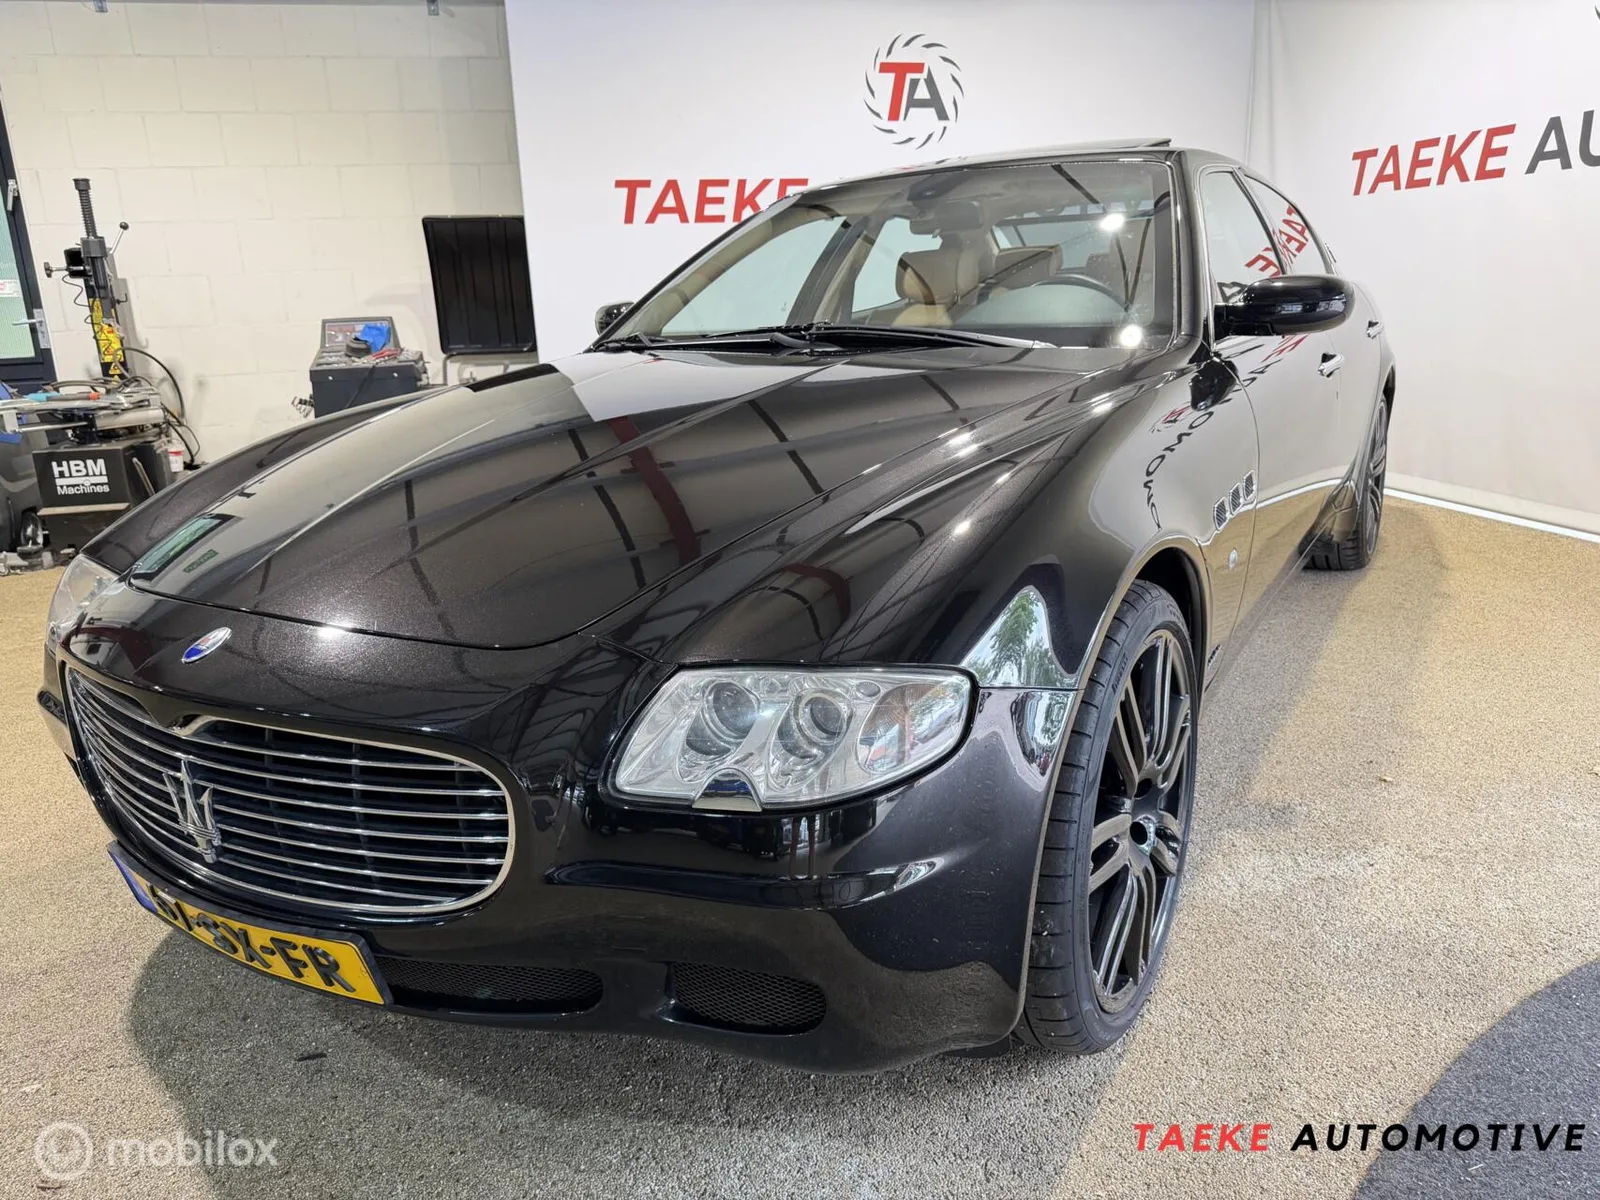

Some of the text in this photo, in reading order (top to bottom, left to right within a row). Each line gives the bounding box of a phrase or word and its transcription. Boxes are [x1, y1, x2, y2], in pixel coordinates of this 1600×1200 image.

[878, 62, 950, 121] TA
[1351, 123, 1517, 196] TAEKE
[51, 459, 107, 477] HBM
[56, 484, 110, 495] Machines
